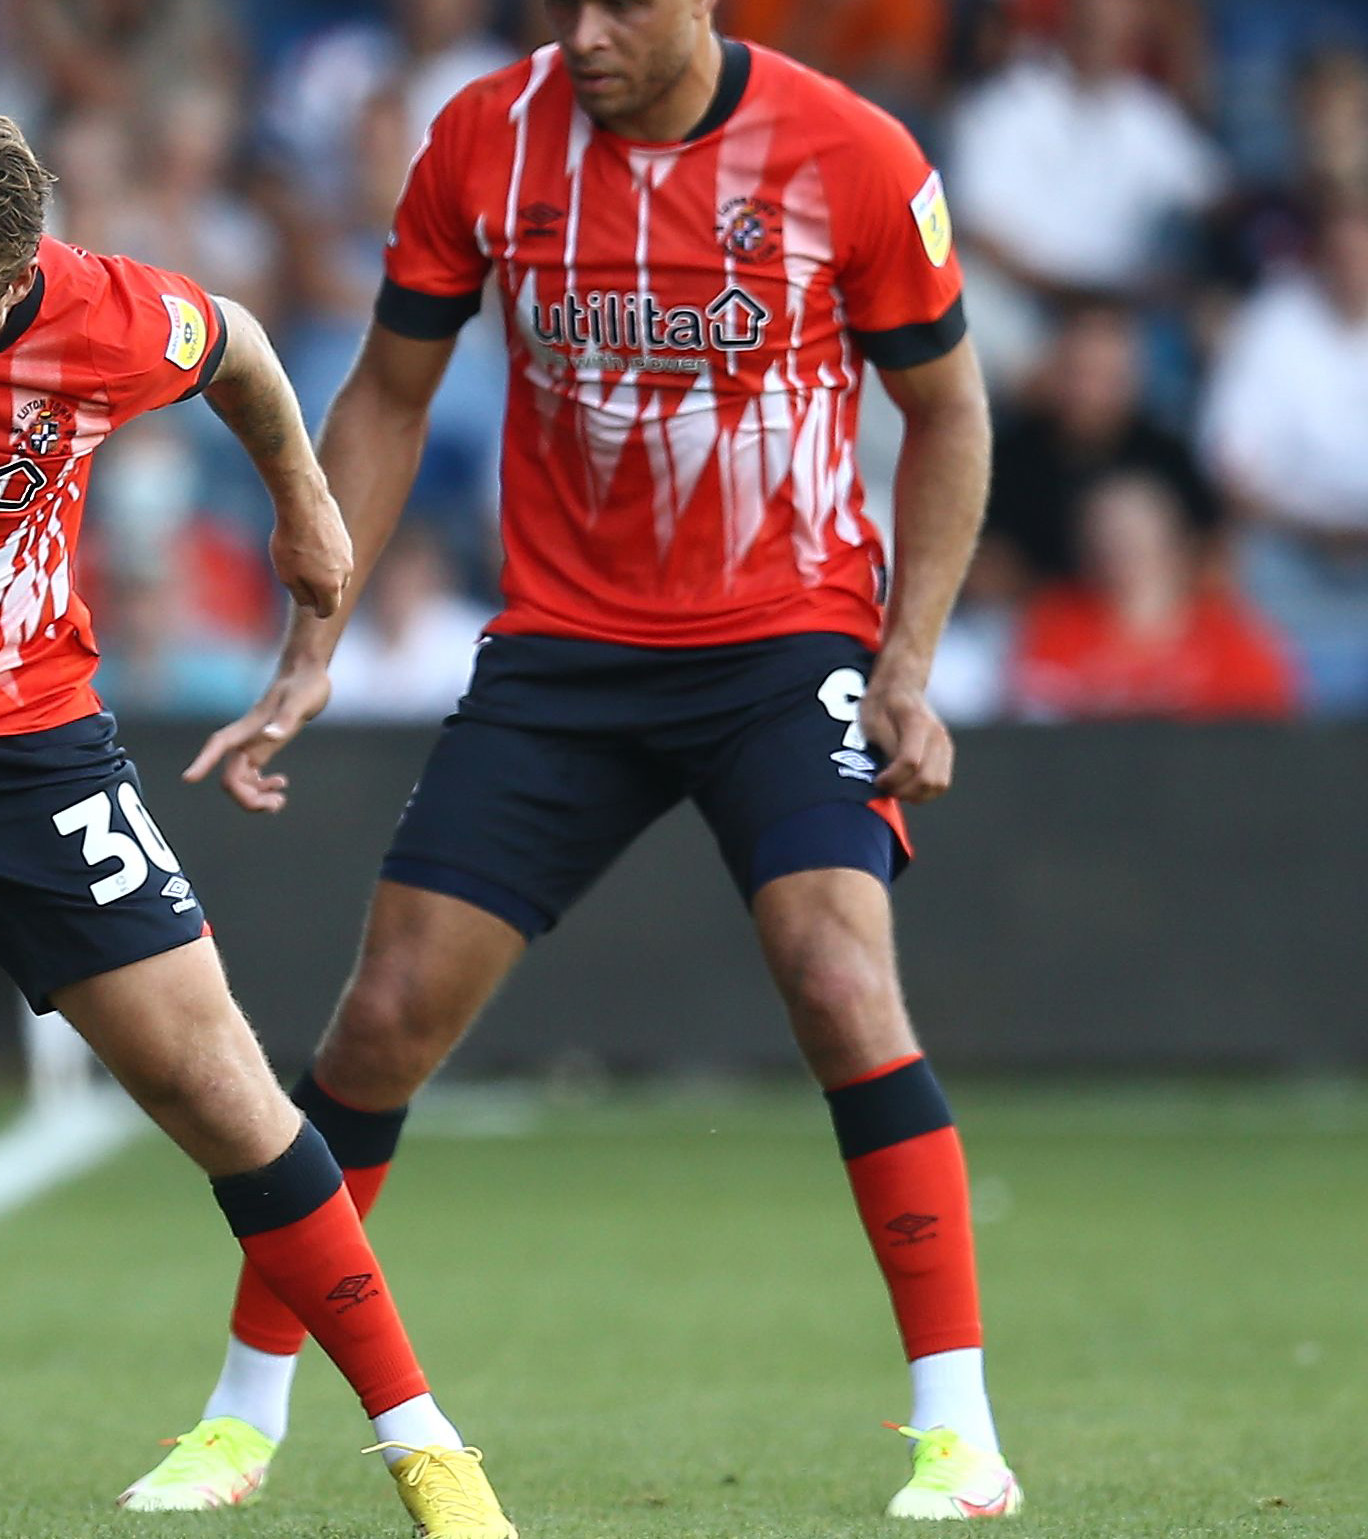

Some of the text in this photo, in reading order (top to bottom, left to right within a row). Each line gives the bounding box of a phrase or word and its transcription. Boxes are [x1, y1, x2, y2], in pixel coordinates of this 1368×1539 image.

[531, 292, 705, 350] utilita
[16, 399, 47, 419] LUTON
[817, 667, 867, 750] 9
[52, 782, 181, 905] 30
